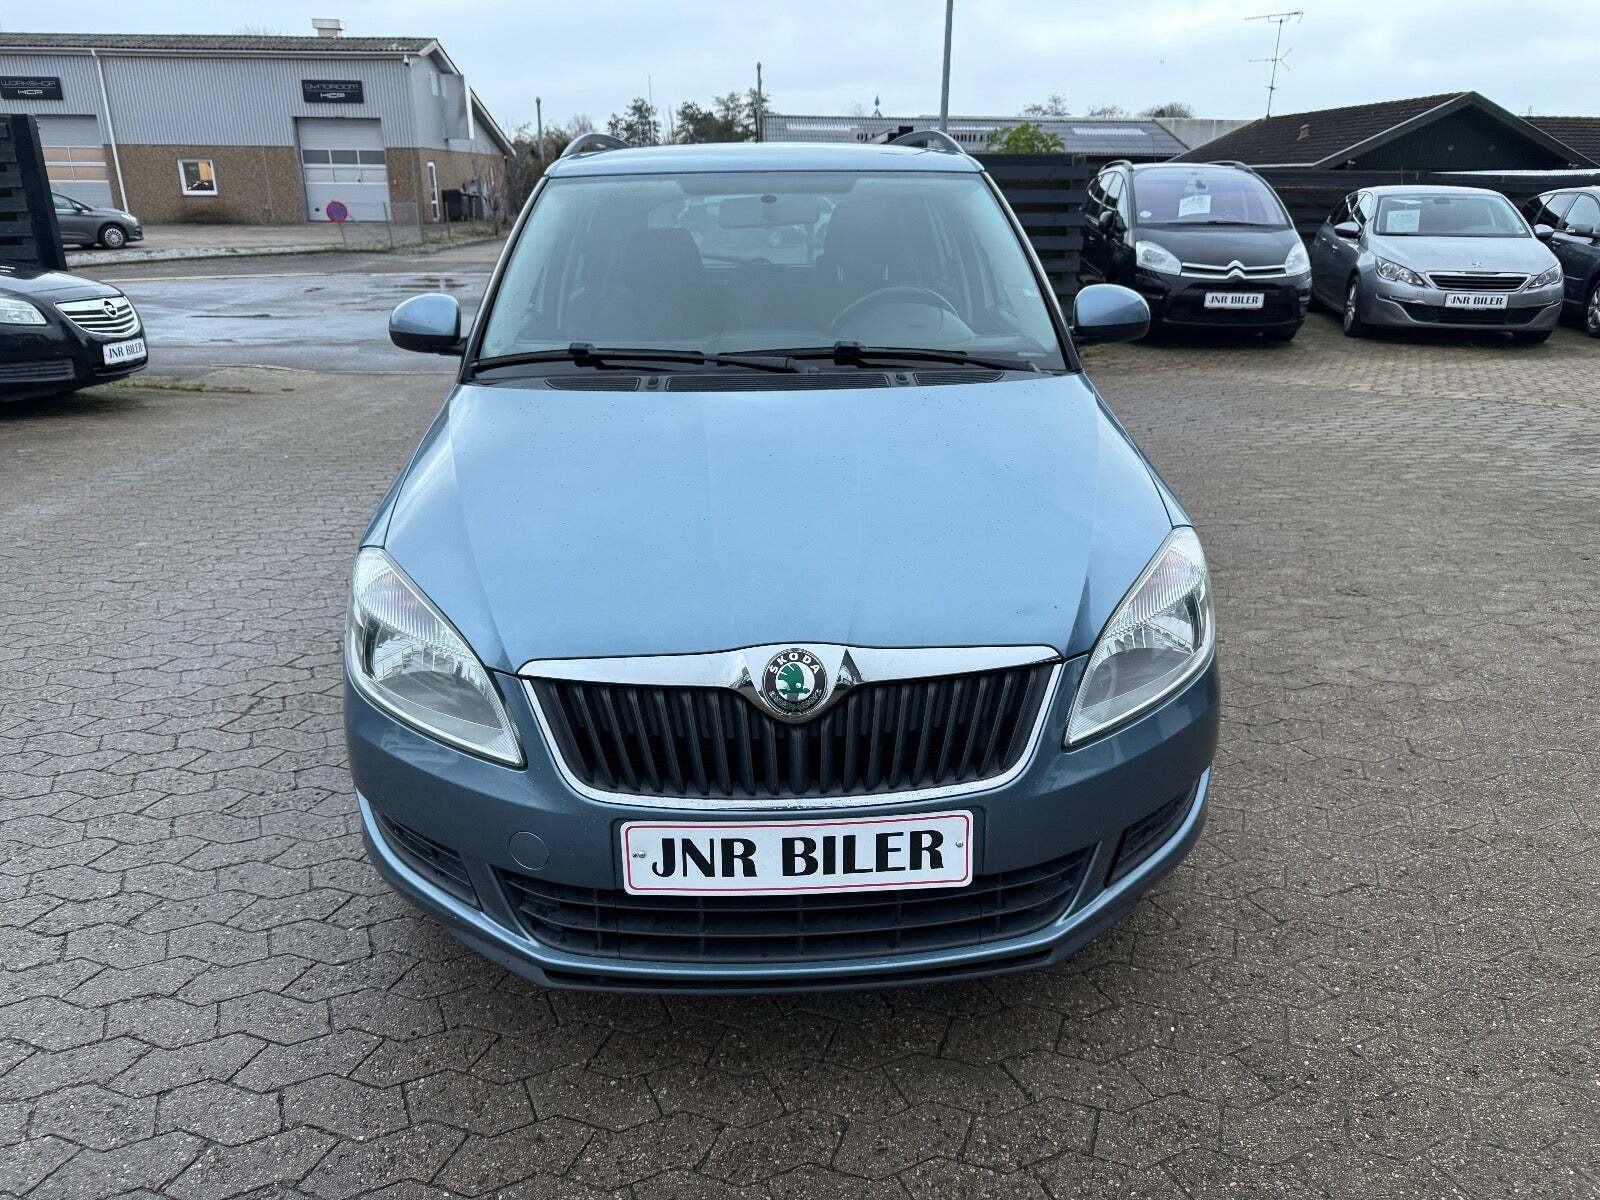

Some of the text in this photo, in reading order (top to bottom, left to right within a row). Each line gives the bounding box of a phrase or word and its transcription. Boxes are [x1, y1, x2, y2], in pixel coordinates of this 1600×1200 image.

[1230, 295, 1259, 305] BILER
[1451, 296, 1503, 305] JNR BILER
[651, 829, 945, 878] JNR BILER
